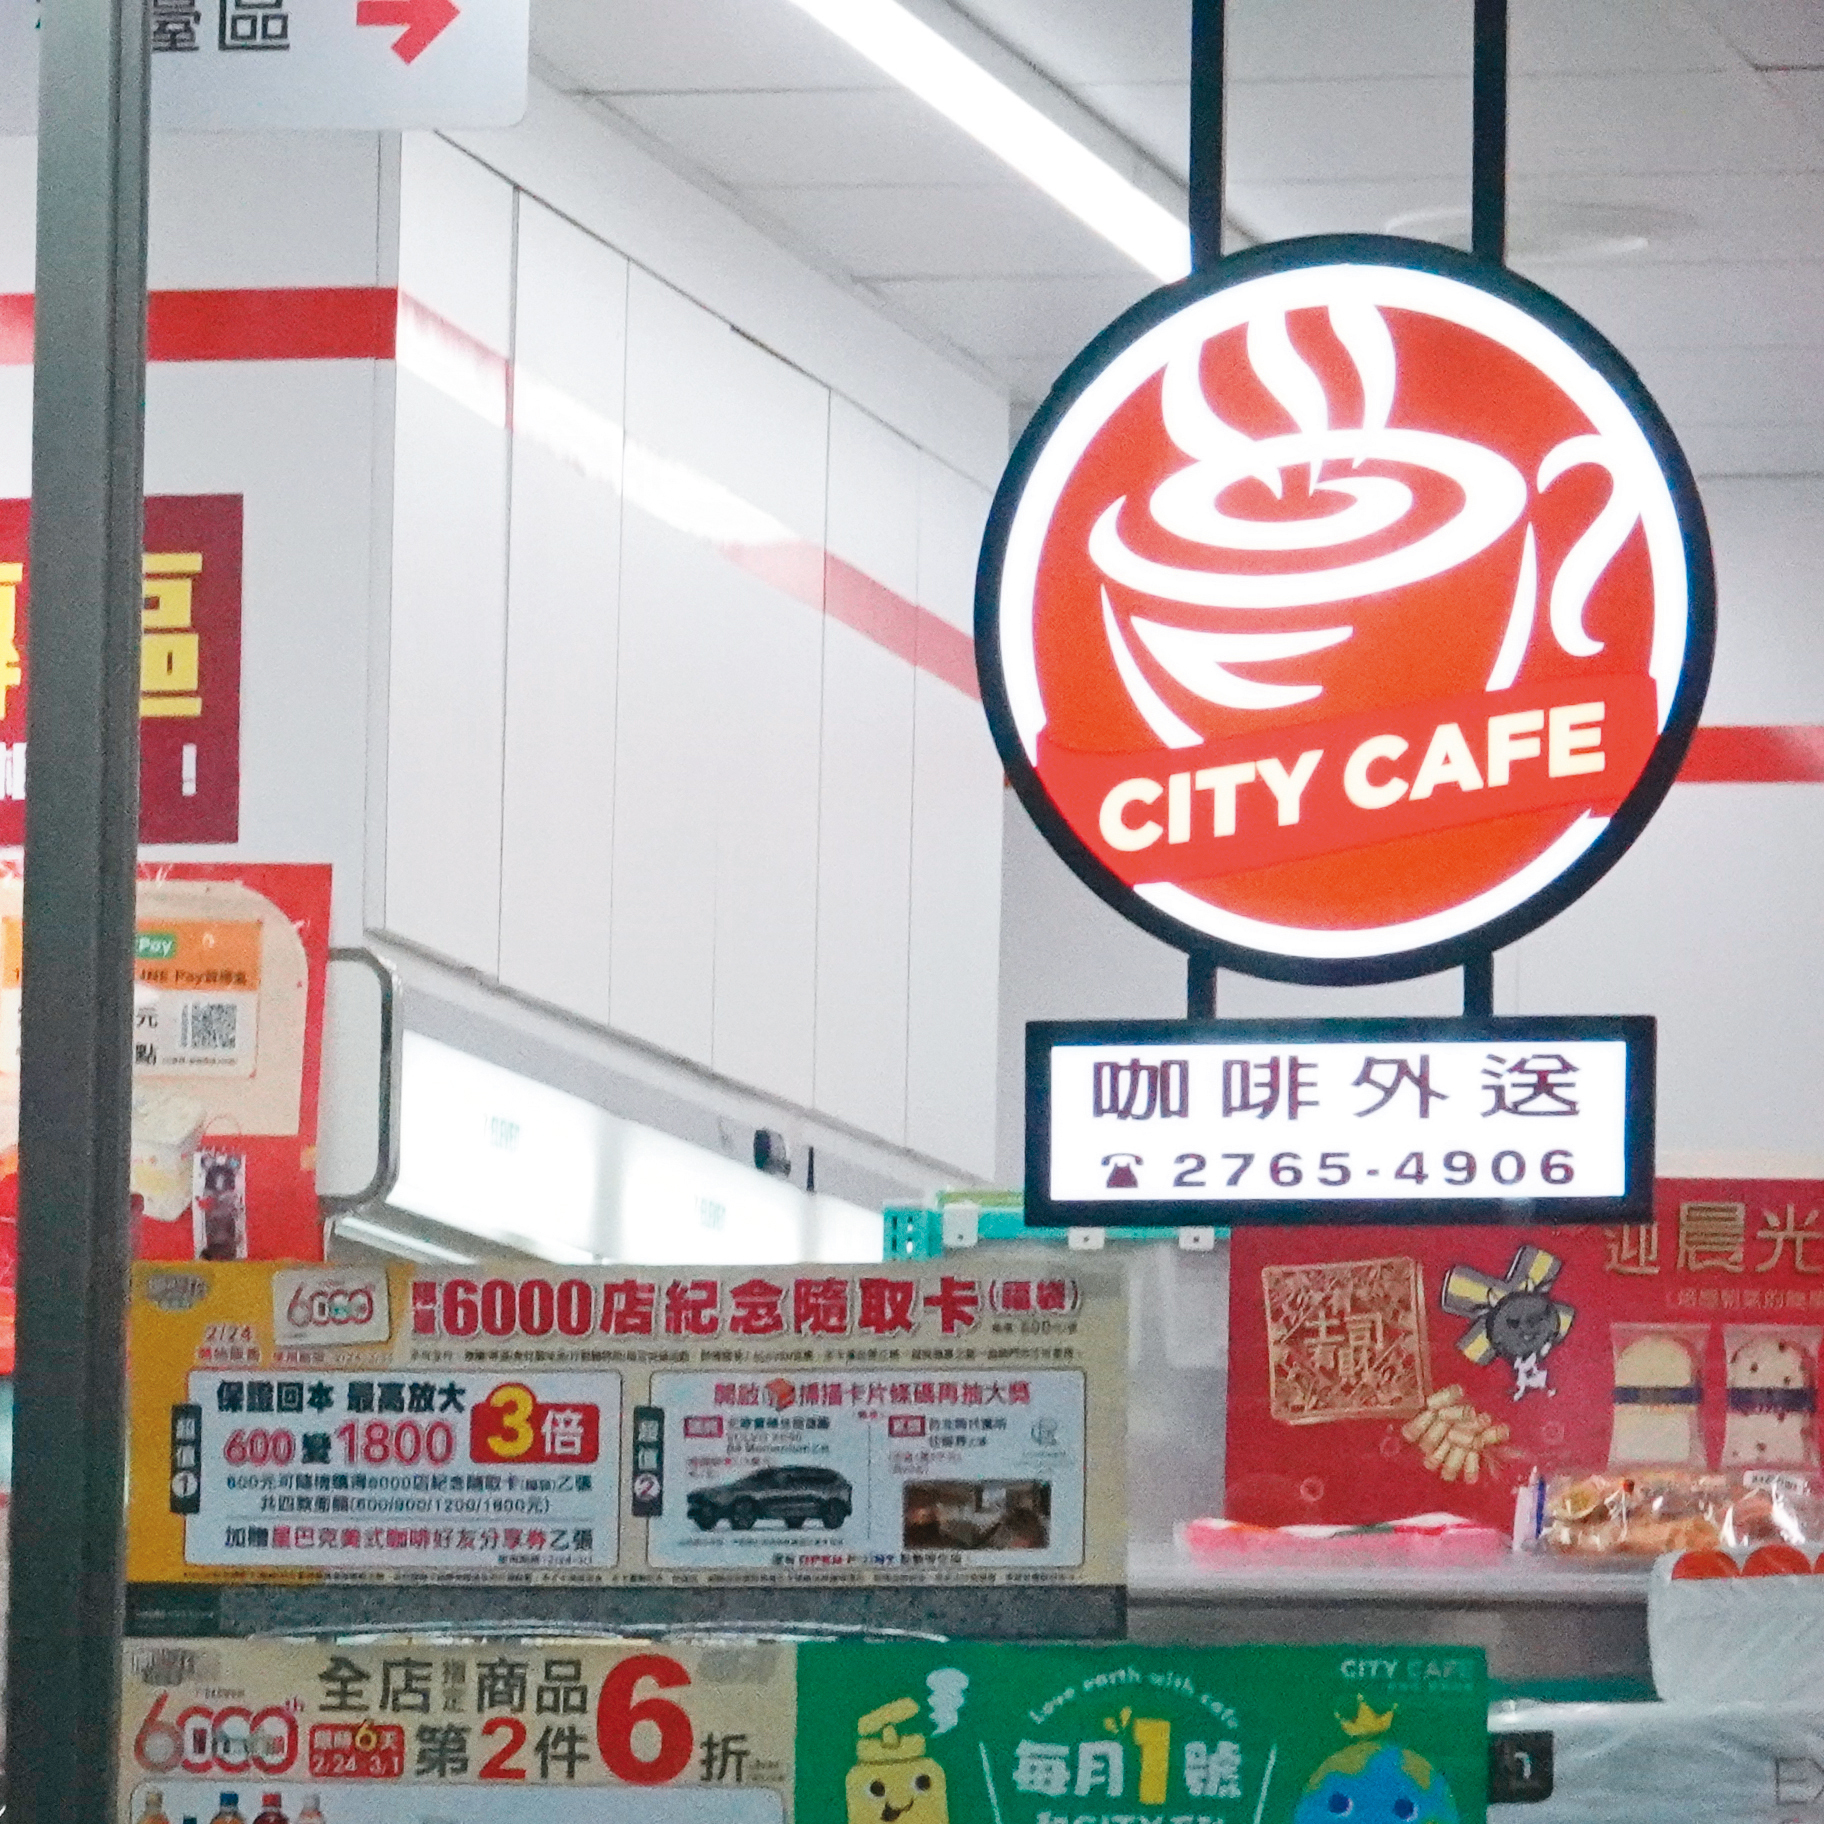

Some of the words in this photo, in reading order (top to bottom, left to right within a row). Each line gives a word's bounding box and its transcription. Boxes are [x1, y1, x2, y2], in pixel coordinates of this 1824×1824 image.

[1098, 748, 1327, 852] CITY
[1342, 701, 1607, 812] CAFE
[1091, 1053, 1582, 1121] 咖啡外送
[1173, 1147, 1577, 1187] 2765-4906
[217, 1380, 335, 1413] 保證回本
[346, 1381, 466, 1413] 最高放大
[414, 1716, 590, 1781] 第2件
[1012, 1717, 1242, 1806] 每月1號
